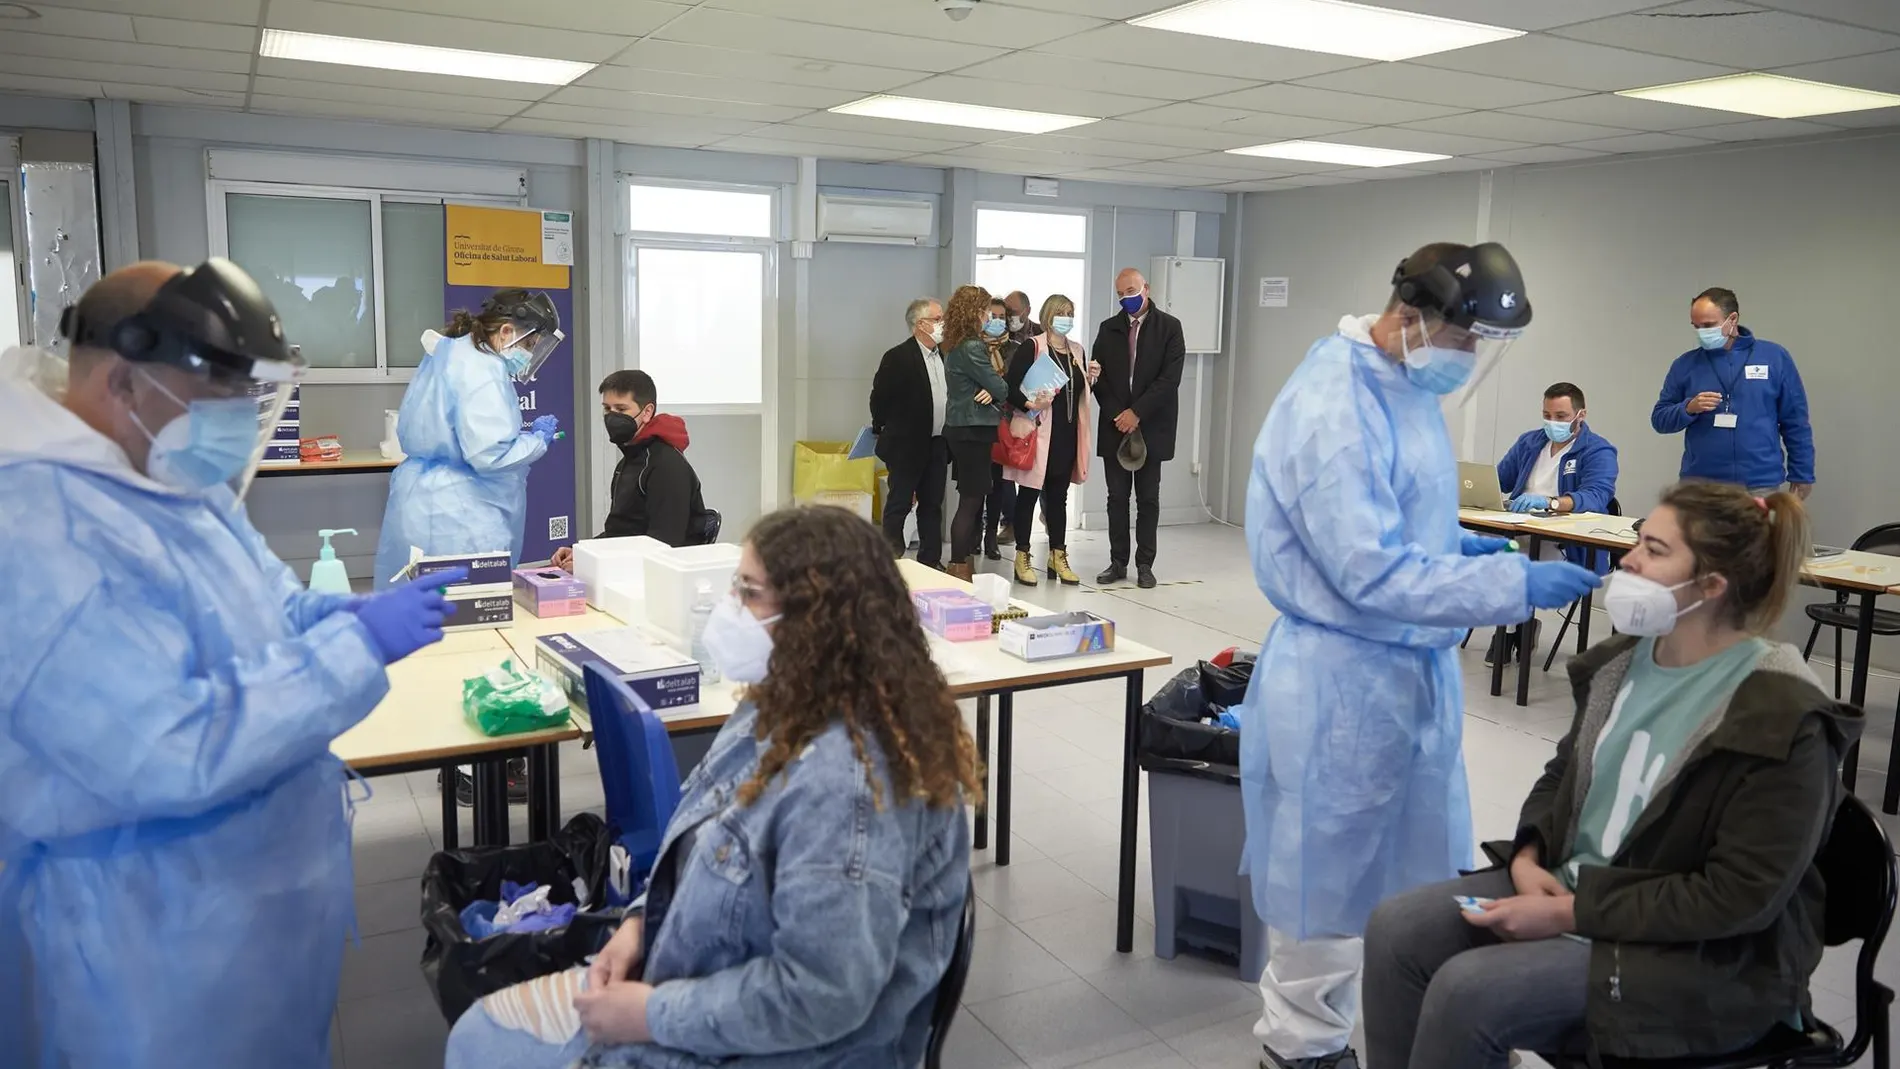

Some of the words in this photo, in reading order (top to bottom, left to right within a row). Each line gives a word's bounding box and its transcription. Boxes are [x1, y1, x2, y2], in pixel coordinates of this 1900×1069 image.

[454, 241, 492, 251] Universitat
[493, 244, 502, 252] de
[503, 245, 525, 253] Girona
[454, 251, 482, 260] Oficina
[491, 253, 510, 261] Salut
[511, 254, 538, 263] Laboral
[479, 559, 507, 568] deltalab
[482, 599, 510, 607] deltalab
[664, 676, 696, 688] deltalab
